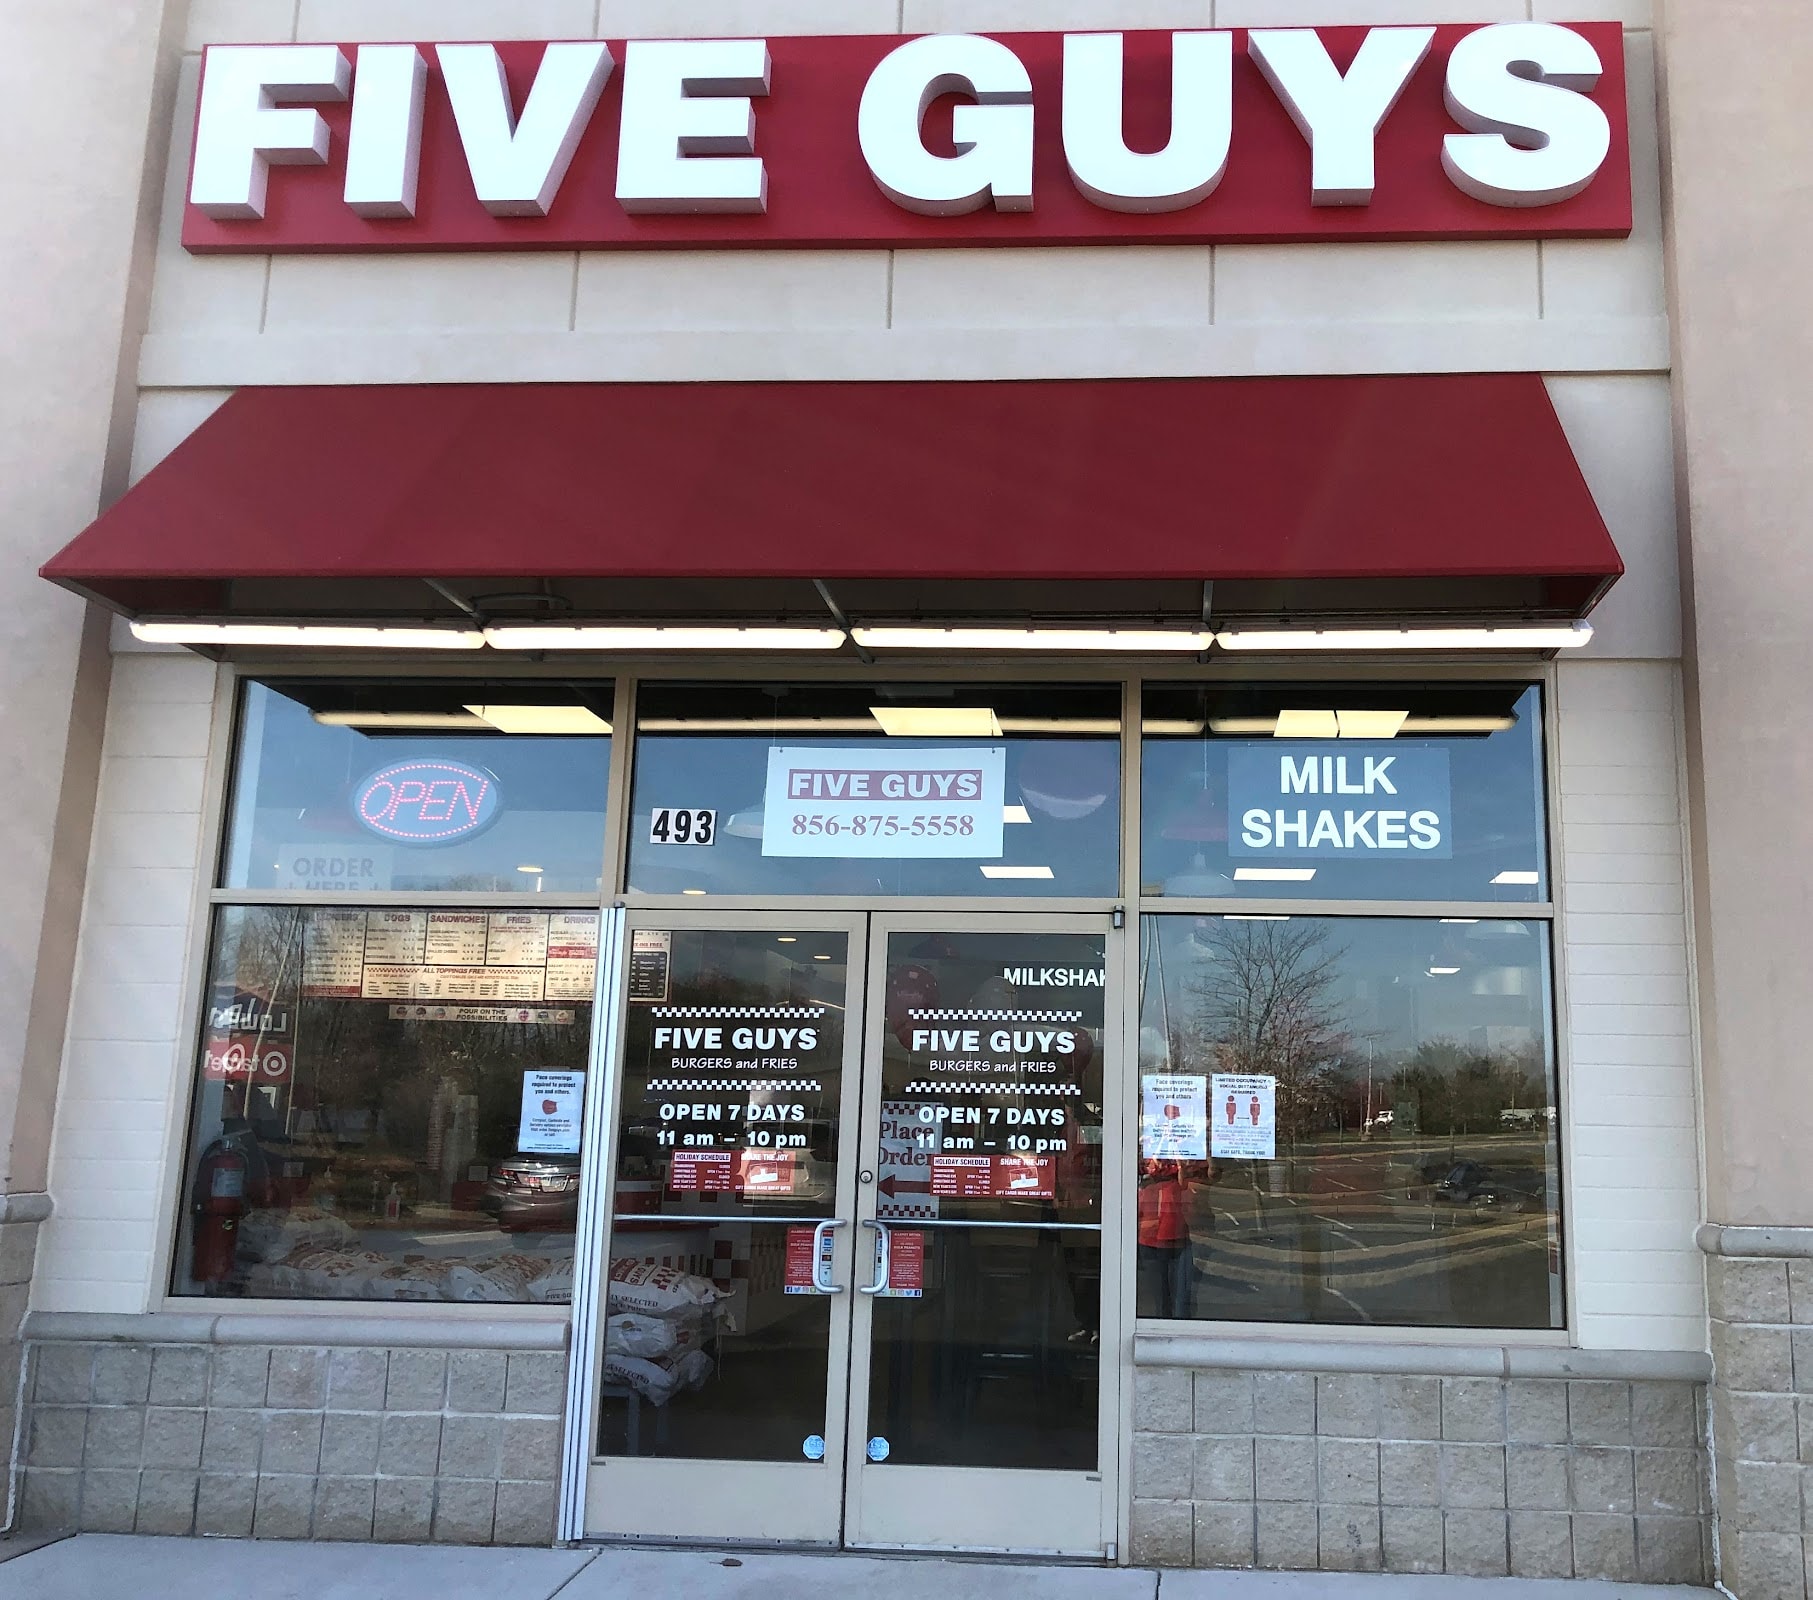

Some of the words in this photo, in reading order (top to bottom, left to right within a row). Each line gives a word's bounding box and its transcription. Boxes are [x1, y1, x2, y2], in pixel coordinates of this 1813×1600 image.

[190, 40, 769, 213] FIVE
[857, 22, 1611, 213] GUYS
[1280, 755, 1398, 794] MILK
[791, 773, 870, 796] FIVE
[881, 773, 978, 798] GUYS
[361, 780, 489, 820] OPEN
[652, 809, 713, 843] 493
[791, 814, 975, 837] 856-875-5558
[1241, 808, 1441, 850] SHAKES
[293, 857, 374, 877] ORDER
[384, 914, 410, 922] DOGS
[430, 915, 486, 923] SANDWICHES
[507, 916, 532, 924] FRIES
[564, 916, 596, 924] DRINKS
[654, 1027, 722, 1049] FIVE
[732, 1028, 818, 1050] GUYS
[912, 1030, 980, 1051] FIVE
[989, 1031, 1076, 1053] GUYS
[671, 1057, 732, 1069] BURGERS
[735, 1058, 758, 1069] and
[762, 1058, 798, 1069] FRIES
[929, 1060, 991, 1072] BURGERS
[994, 1061, 1016, 1072] and
[1020, 1061, 1056, 1073] FRIES
[659, 1104, 721, 1121] OPEN
[728, 1104, 741, 1121] 7
[747, 1104, 805, 1121] DAYS
[918, 1106, 981, 1124] OPEN
[987, 1107, 1001, 1124] 7
[1006, 1107, 1065, 1125] DAYS
[657, 1130, 675, 1145] 11
[683, 1133, 714, 1145] am
[747, 1131, 770, 1146] 10
[775, 1133, 807, 1149] pm
[916, 1134, 935, 1149] 11
[943, 1136, 974, 1149] am
[1007, 1135, 1030, 1150] 10
[1036, 1137, 1067, 1153] pm
[960, 1158, 989, 1166] SCHEDULE
[1000, 1158, 1022, 1166] SHARE
[1036, 1158, 1049, 1166] JOY
